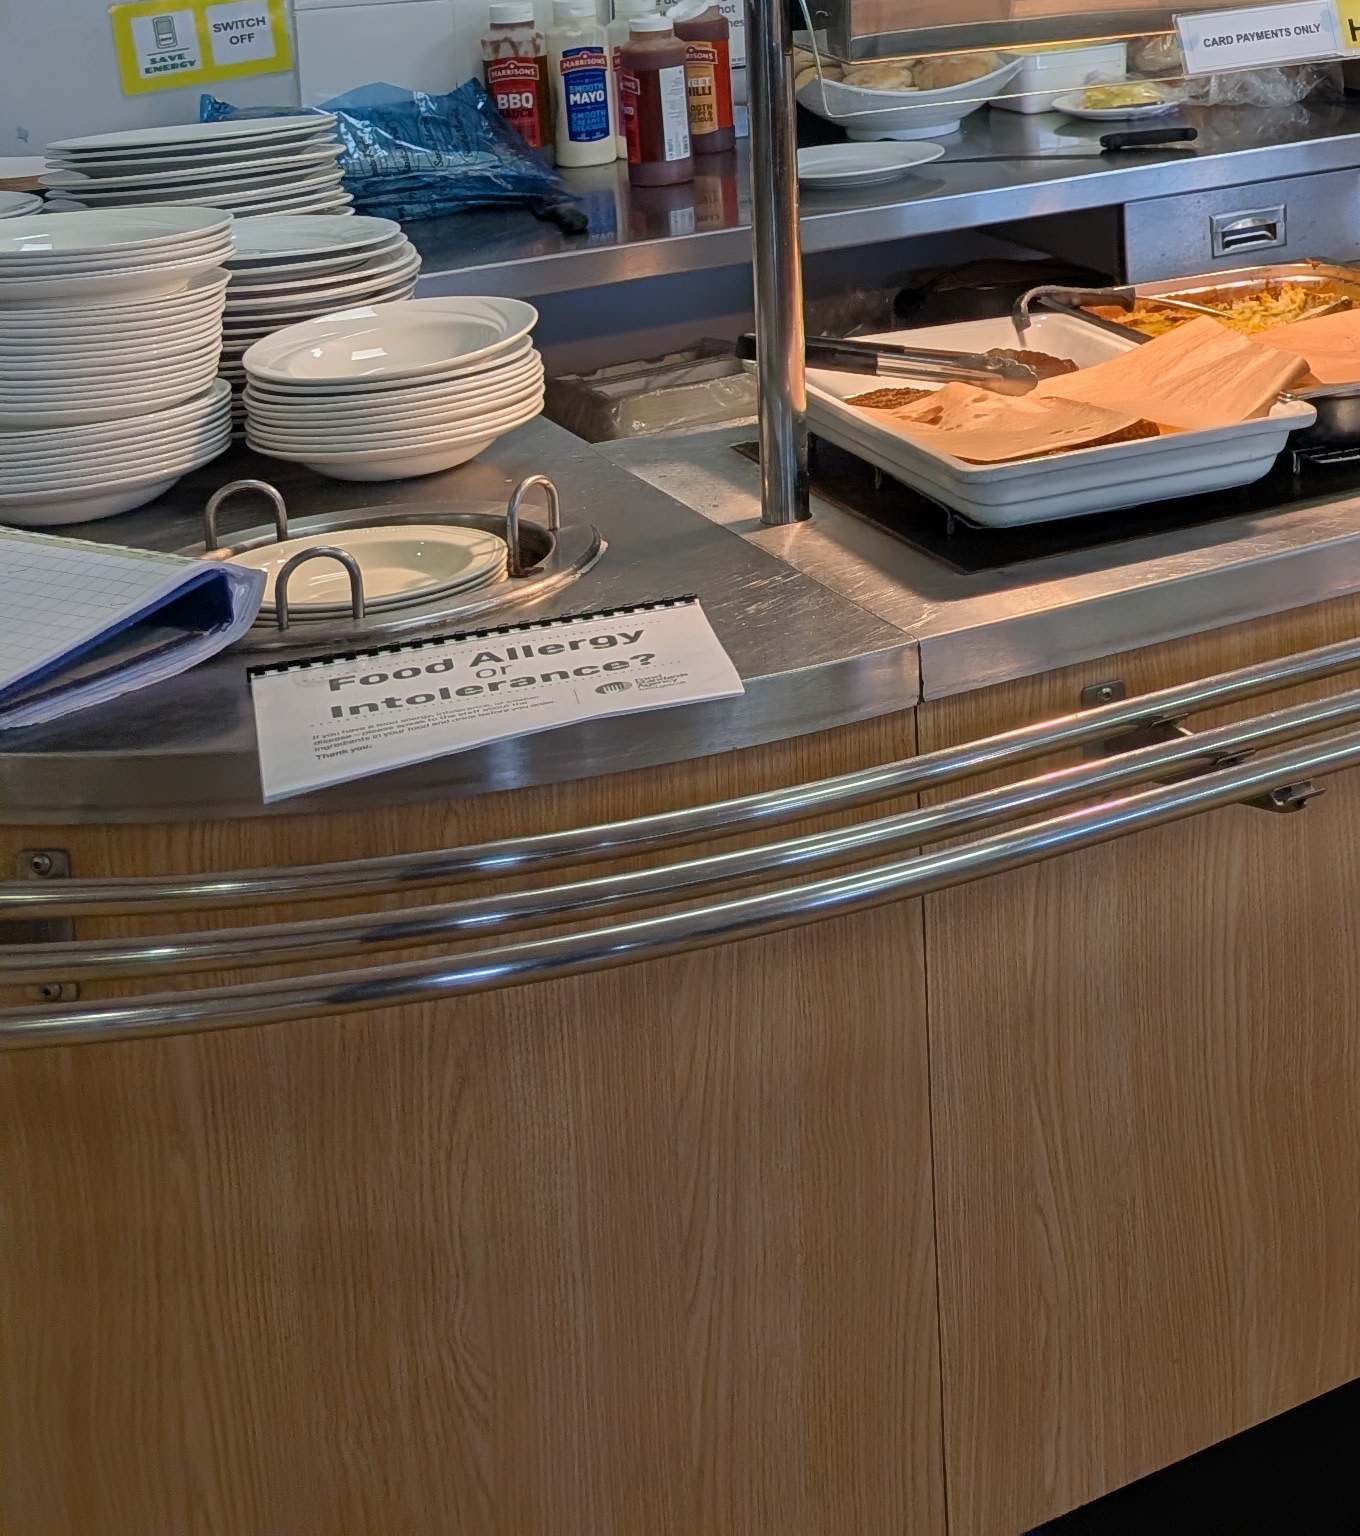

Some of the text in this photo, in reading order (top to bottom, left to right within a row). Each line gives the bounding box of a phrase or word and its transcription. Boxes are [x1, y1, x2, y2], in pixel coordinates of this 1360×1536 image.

[212, 16, 266, 33] SWITCH
[229, 32, 255, 46] OFF
[1203, 23, 1321, 48] CARD PAYMENTS ONLY
[149, 52, 186, 65] SAVE
[562, 57, 606, 69] HARRISONS
[144, 59, 196, 74] ENERGY
[491, 68, 535, 77] HARRISONS
[569, 83, 604, 93] SMOOTH
[497, 92, 533, 109] BBQ
[569, 90, 605, 105] MAYO
[328, 629, 645, 691] Food Allergy
[475, 664, 513, 680] or
[330, 653, 656, 719] Intolerance?
[342, 726, 366, 734] have
[315, 744, 373, 760] Thank you.
